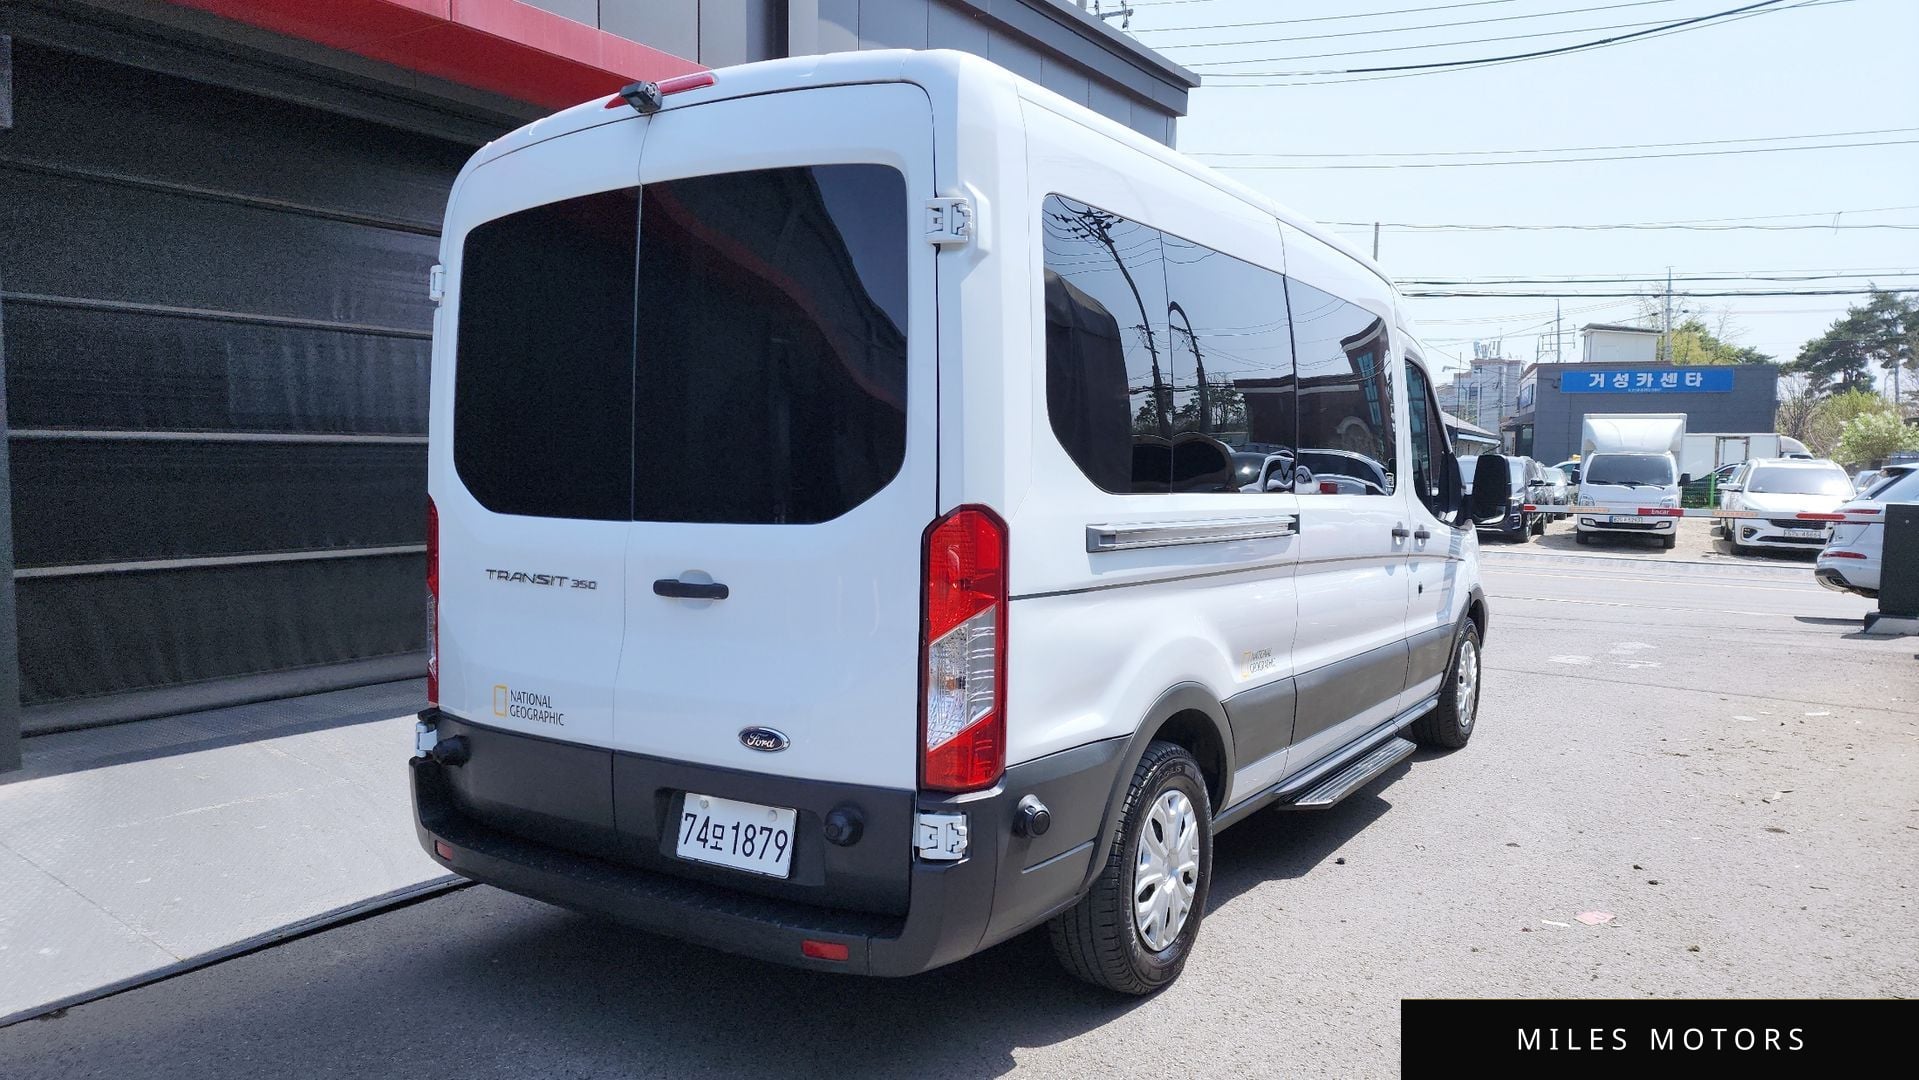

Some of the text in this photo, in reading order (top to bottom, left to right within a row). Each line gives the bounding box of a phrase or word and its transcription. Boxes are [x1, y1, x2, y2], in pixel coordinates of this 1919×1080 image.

[1588, 371, 1703, 388] 거성카센타
[485, 568, 598, 591] TRANSIT 350
[510, 689, 553, 709] NATIONAL
[509, 704, 565, 727] GEOGRAPHIC
[746, 733, 776, 749] Ford
